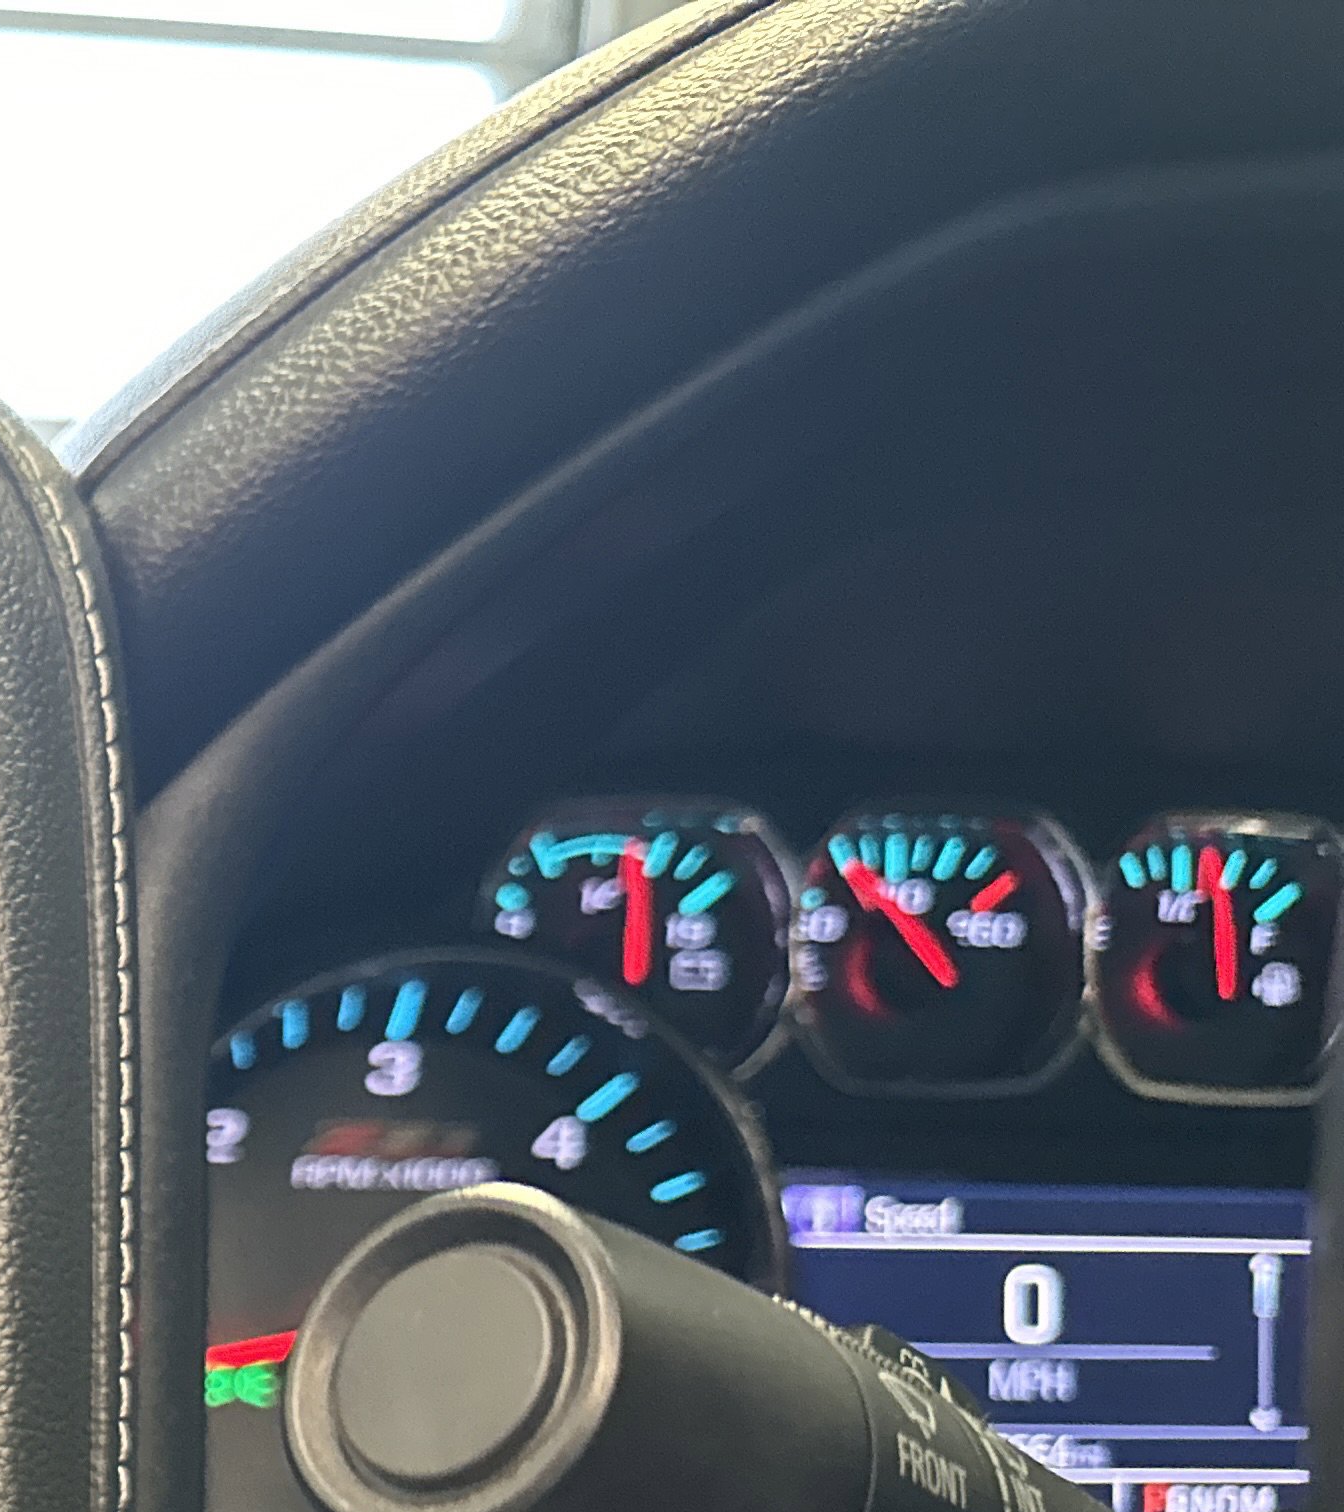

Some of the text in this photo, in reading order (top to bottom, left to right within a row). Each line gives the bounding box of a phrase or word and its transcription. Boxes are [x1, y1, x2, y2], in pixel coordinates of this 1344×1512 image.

[364, 1040, 424, 1097] 3
[206, 1107, 250, 1164] 2
[530, 1115, 588, 1170] 4
[1003, 1263, 1066, 1345] 0
[988, 1358, 1079, 1402] MPH
[896, 1432, 968, 1510] FRONT
